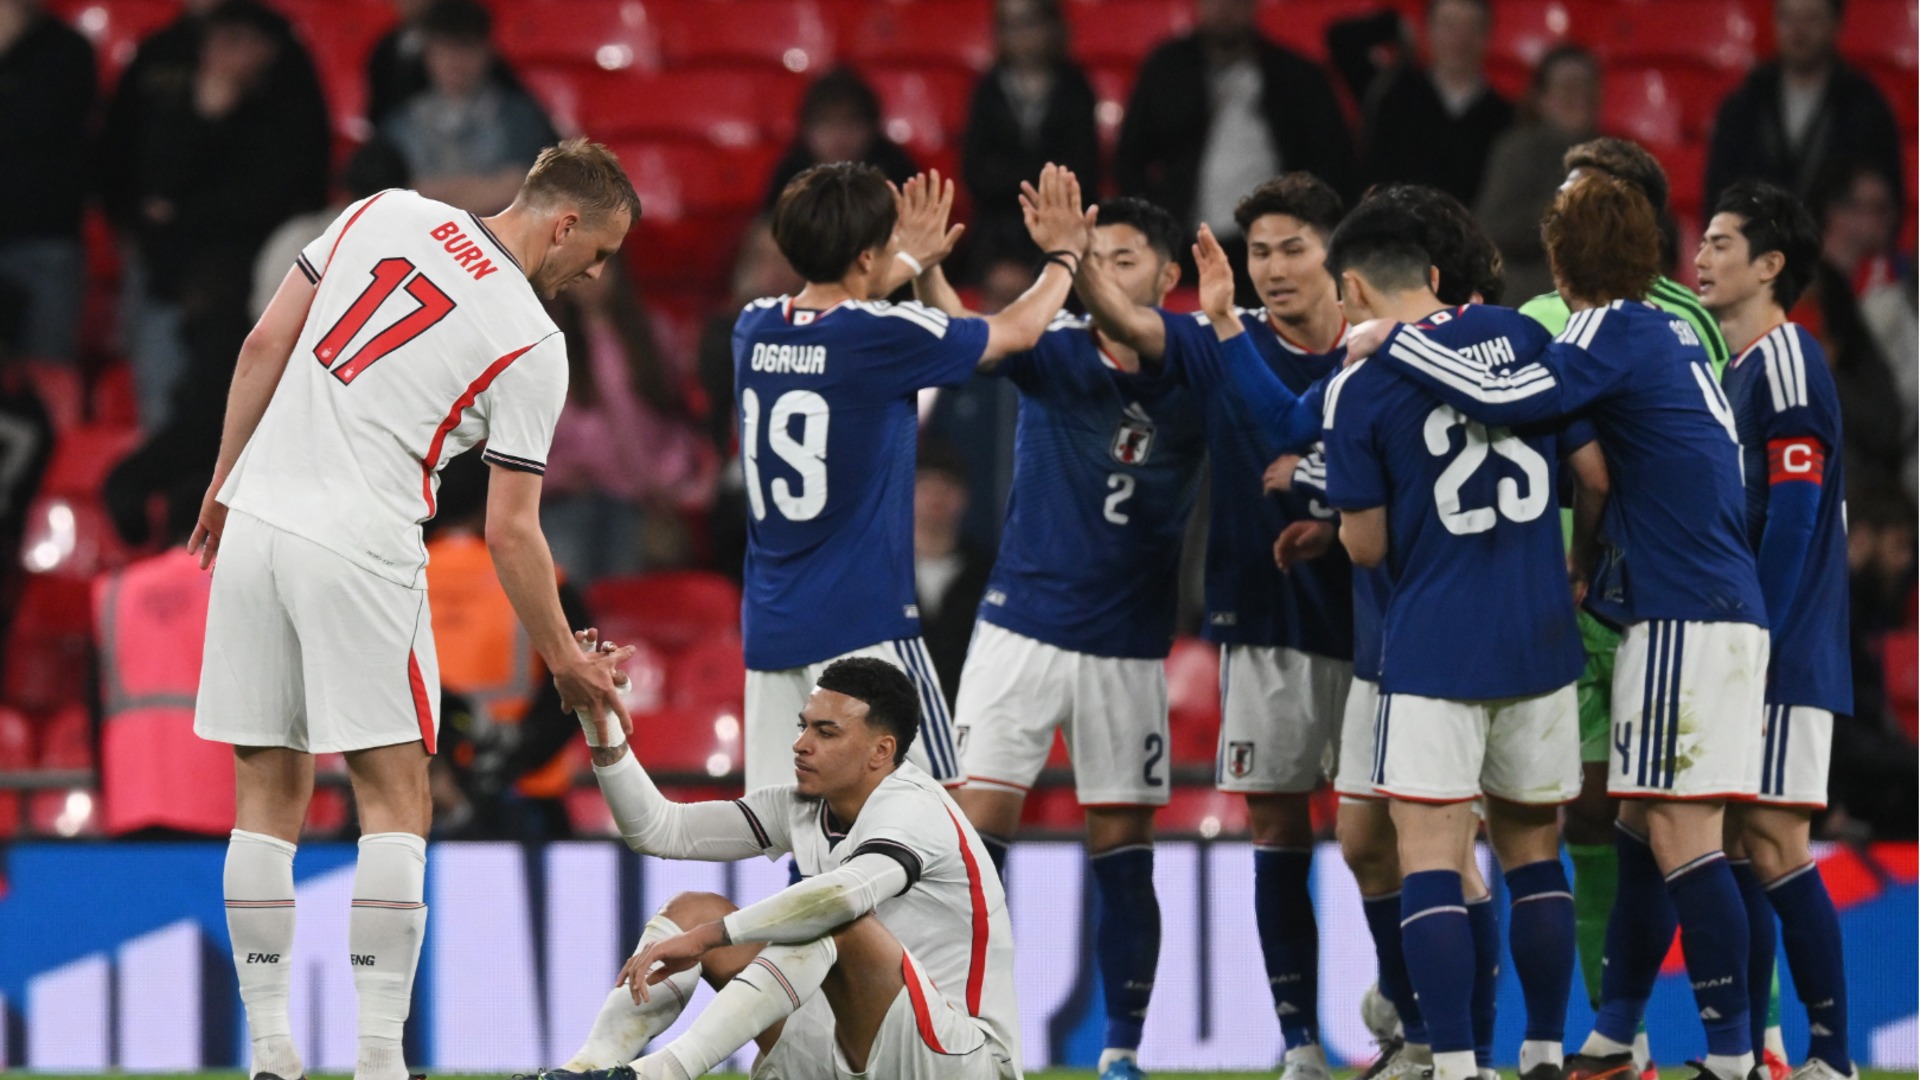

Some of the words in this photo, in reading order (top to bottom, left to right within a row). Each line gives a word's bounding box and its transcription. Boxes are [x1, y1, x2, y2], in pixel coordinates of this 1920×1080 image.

[430, 221, 498, 281] BURN
[313, 257, 457, 387] 17
[752, 342, 827, 375] OGAWA
[742, 387, 830, 521] 19
[1423, 403, 1549, 535] 25
[1783, 443, 1812, 473] C
[1104, 473, 1135, 525] 2
[1143, 732, 1163, 787] 2
[1614, 719, 1632, 776] 4
[246, 952, 280, 964] ENG
